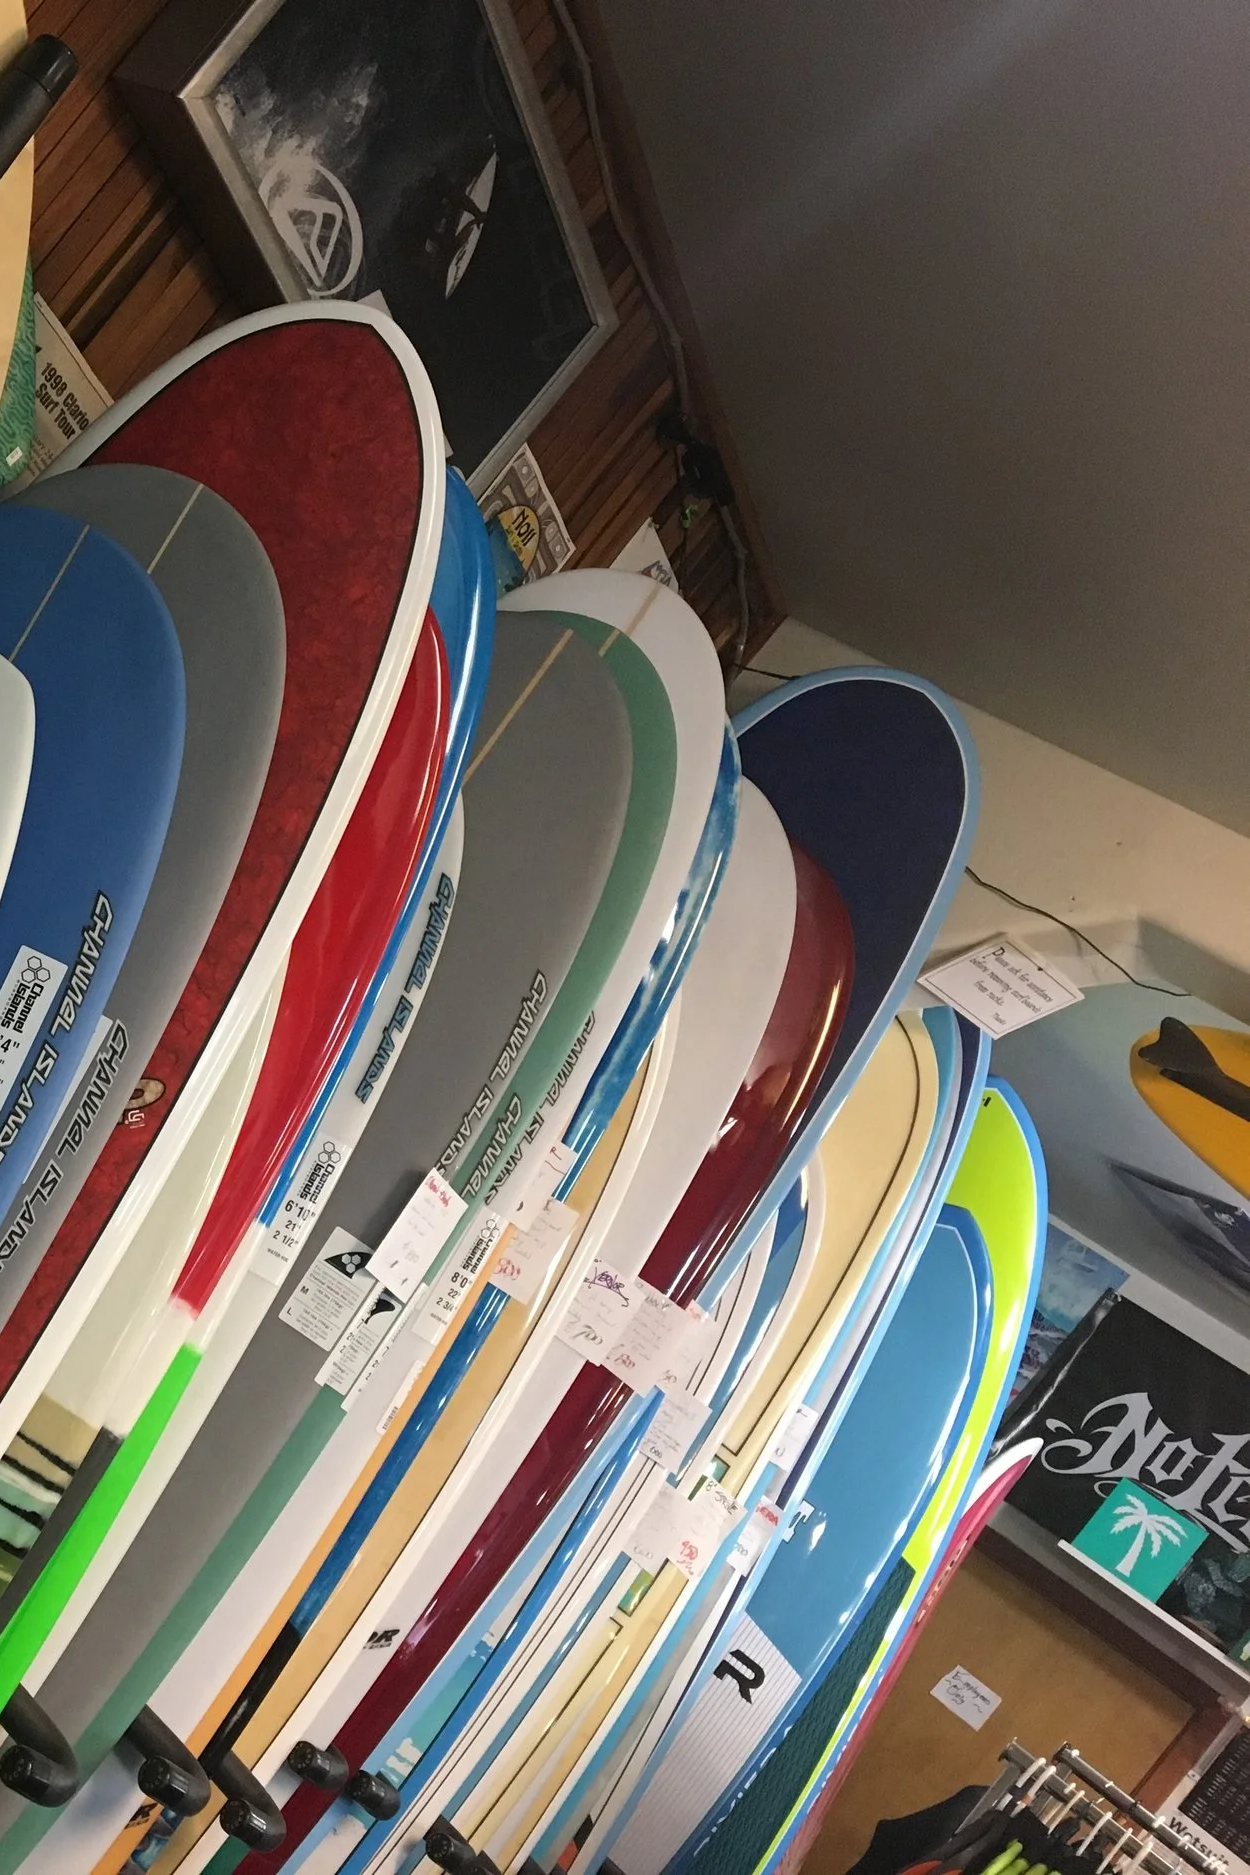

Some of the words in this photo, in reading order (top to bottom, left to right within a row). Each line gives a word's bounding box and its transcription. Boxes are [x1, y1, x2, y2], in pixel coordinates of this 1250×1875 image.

[40, 361, 68, 398] 1998
[35, 382, 60, 415] Surf
[54, 408, 77, 440] Tour
[404, 872, 456, 994] CHANNEL
[51, 890, 114, 1037] CHANNEL
[0, 981, 31, 1029] Islands
[13, 981, 45, 1034] Channel
[489, 967, 549, 1083] CHANNEL
[354, 994, 414, 1104] ISLANDS
[56, 1018, 129, 1157] CHANNEL
[460, 1091, 523, 1200] CHANNEL
[299, 1162, 325, 1201] Islands
[308, 1163, 336, 1204] Channel
[272, 1230, 281, 1240] 2
